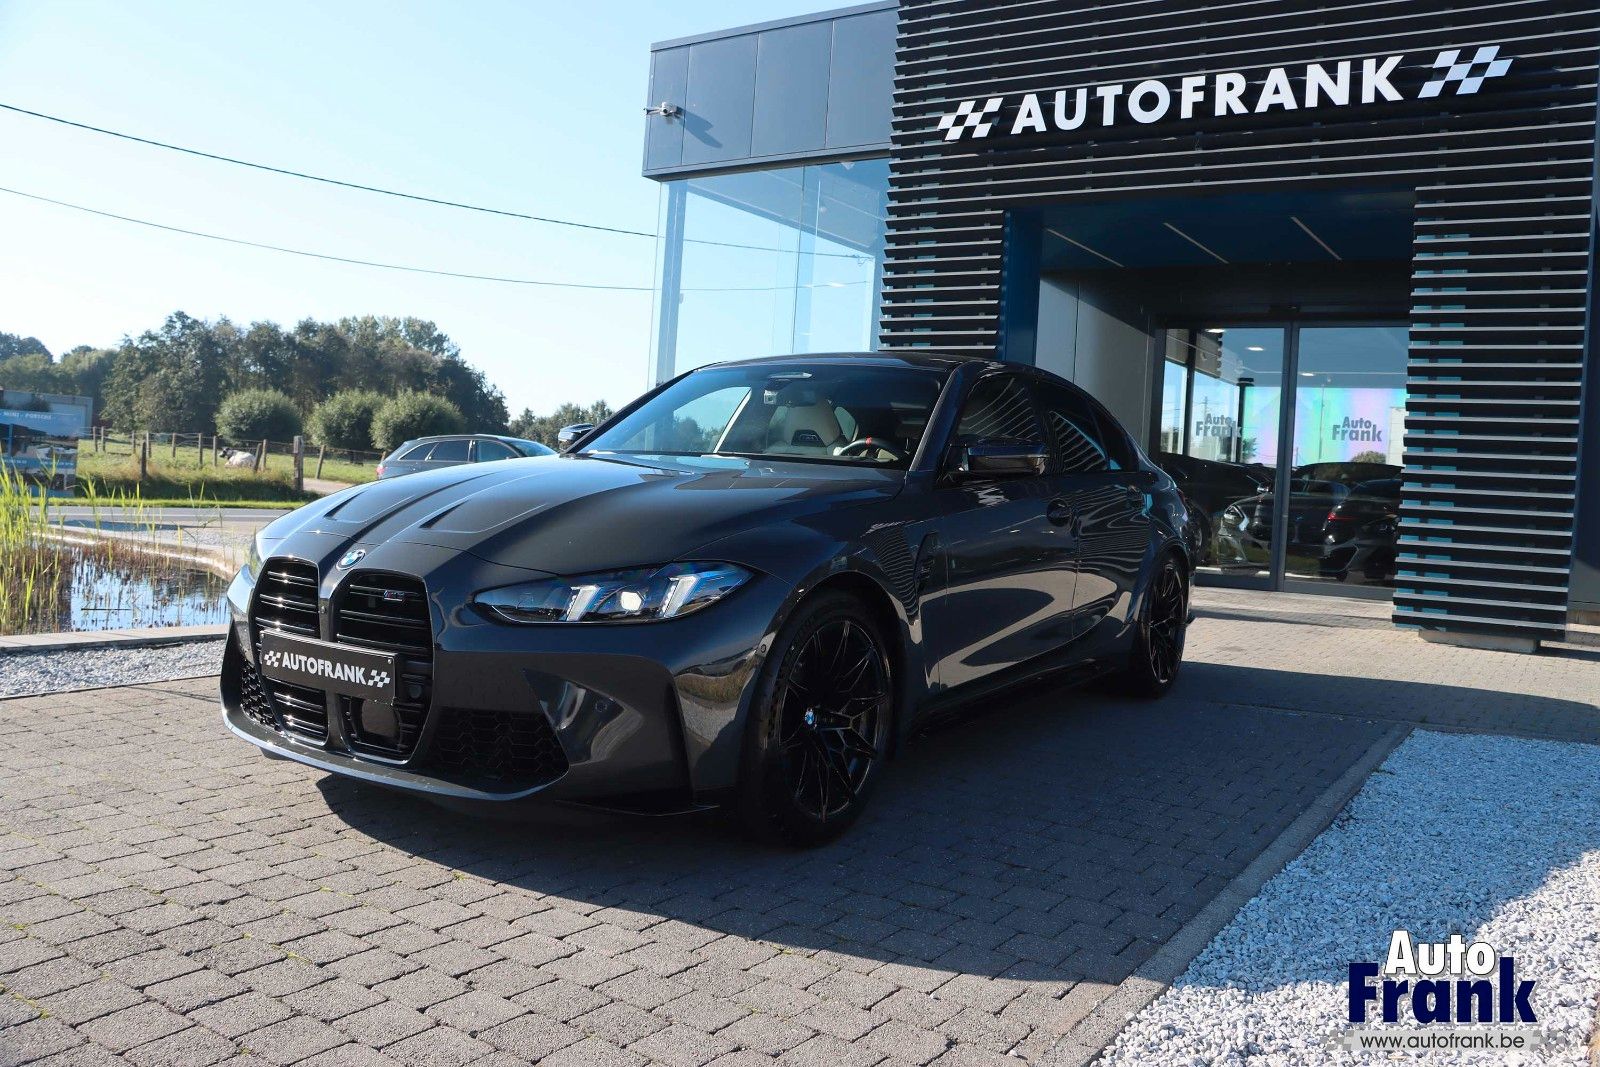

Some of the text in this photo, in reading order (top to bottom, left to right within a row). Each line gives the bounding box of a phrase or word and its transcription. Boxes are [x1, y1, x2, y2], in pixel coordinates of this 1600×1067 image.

[1010, 55, 1405, 135] AUTOFRANK
[1204, 413, 1232, 425] Auto
[1342, 416, 1372, 429] Auto
[1332, 424, 1383, 442] Frank
[281, 651, 367, 685] AUTOFRANK
